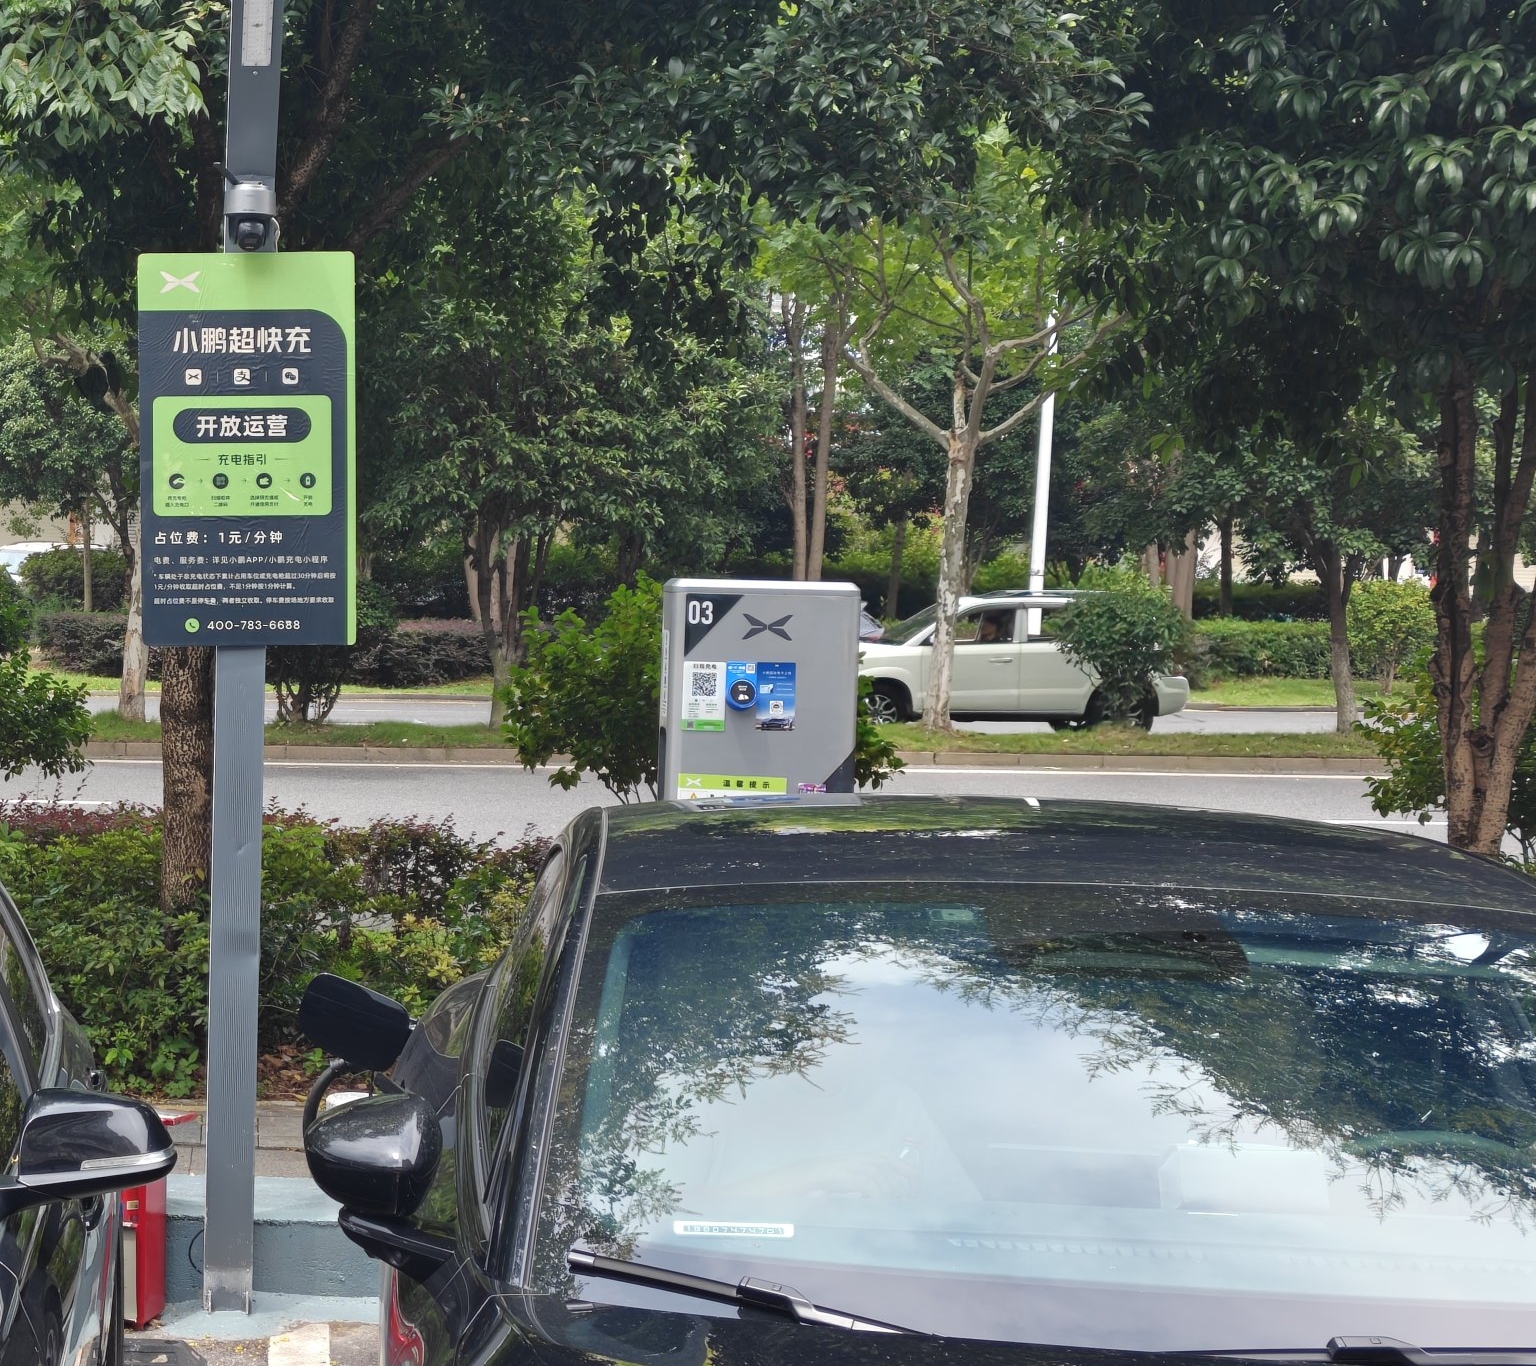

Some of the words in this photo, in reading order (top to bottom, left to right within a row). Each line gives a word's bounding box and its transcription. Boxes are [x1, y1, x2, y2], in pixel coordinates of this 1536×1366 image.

[173, 326, 312, 354] 小鹏超快充
[196, 414, 289, 438] 开放运营
[218, 453, 267, 466] 充电指引
[688, 600, 714, 625] 03
[207, 620, 301, 631] 400-783-6688
[722, 779, 770, 789] 温馨提示
